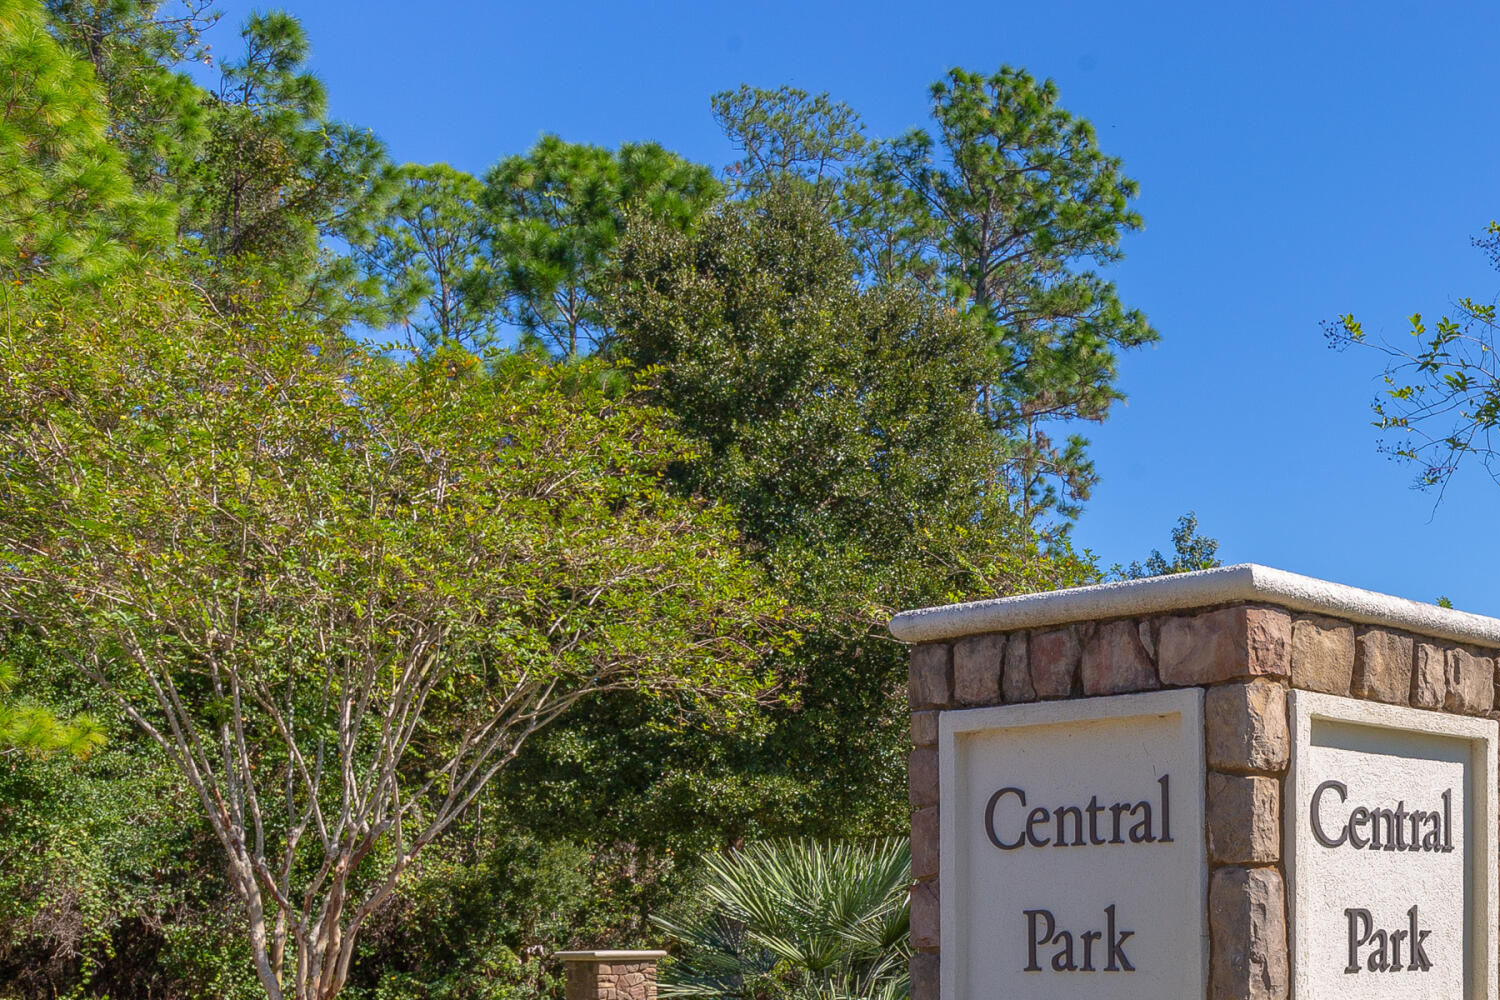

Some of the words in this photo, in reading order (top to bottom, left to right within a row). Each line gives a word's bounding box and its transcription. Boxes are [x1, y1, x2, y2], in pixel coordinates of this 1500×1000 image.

[984, 774, 1174, 850] Central
[1310, 780, 1455, 853] Central
[1023, 904, 1136, 972] Park
[1344, 905, 1434, 974] Park
